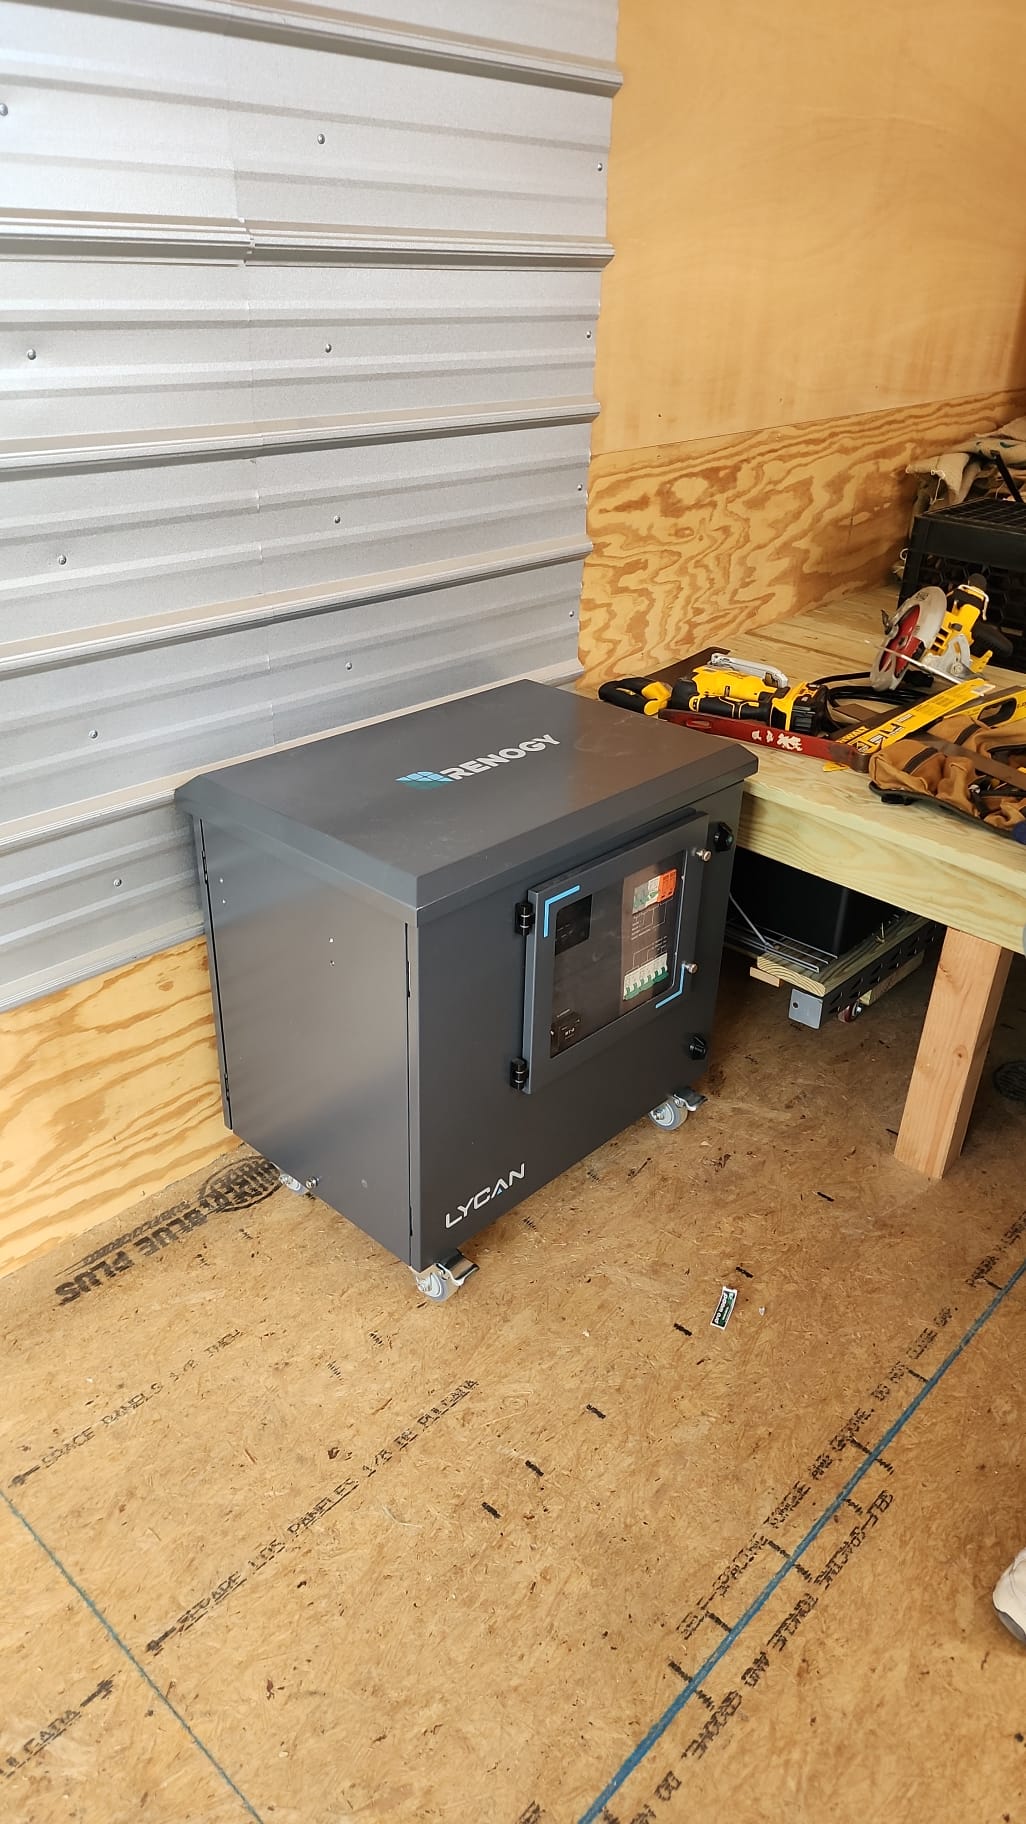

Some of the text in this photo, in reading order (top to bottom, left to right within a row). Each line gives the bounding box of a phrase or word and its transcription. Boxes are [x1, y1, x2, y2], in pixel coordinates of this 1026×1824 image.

[439, 733, 561, 781] RENOGY
[445, 1163, 525, 1229] LYCAN
[133, 1208, 208, 1257] BLUE
[54, 1250, 135, 1306] PLUS
[714, 1312, 722, 1324] pro
[718, 1292, 728, 1313] wood
[41, 1430, 95, 1468] SPACE
[101, 1382, 163, 1429] PANELS
[811, 1453, 833, 1480] AND
[768, 1592, 819, 1652] TONGUE
[741, 1651, 771, 1688] AND
[654, 1769, 682, 1802] DO
